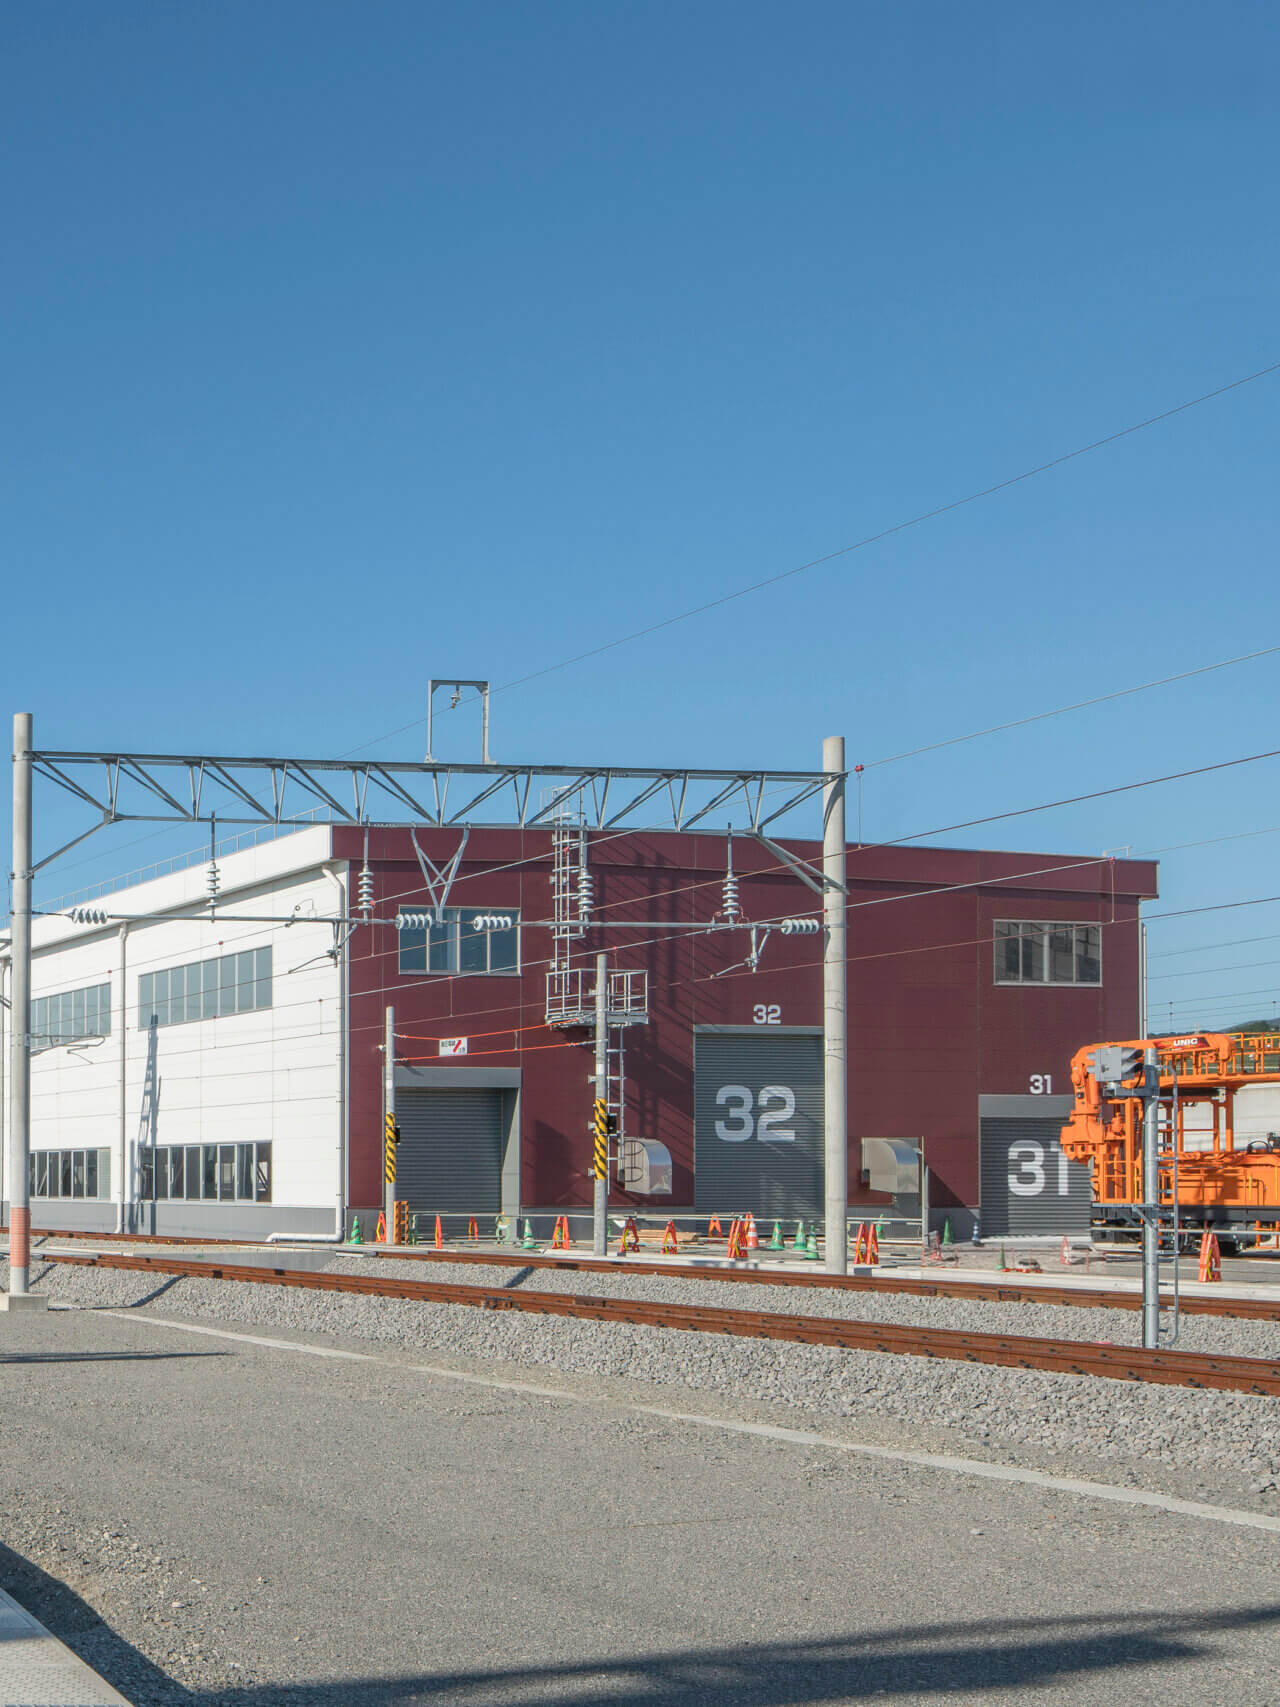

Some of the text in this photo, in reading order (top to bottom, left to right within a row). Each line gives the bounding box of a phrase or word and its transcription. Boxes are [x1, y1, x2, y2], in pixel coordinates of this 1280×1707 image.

[753, 1004, 781, 1024] 32
[1173, 1037, 1198, 1048] UNIC
[1029, 1074, 1052, 1094] 31
[714, 1085, 795, 1141] 32
[1008, 1140, 1069, 1196] 31
